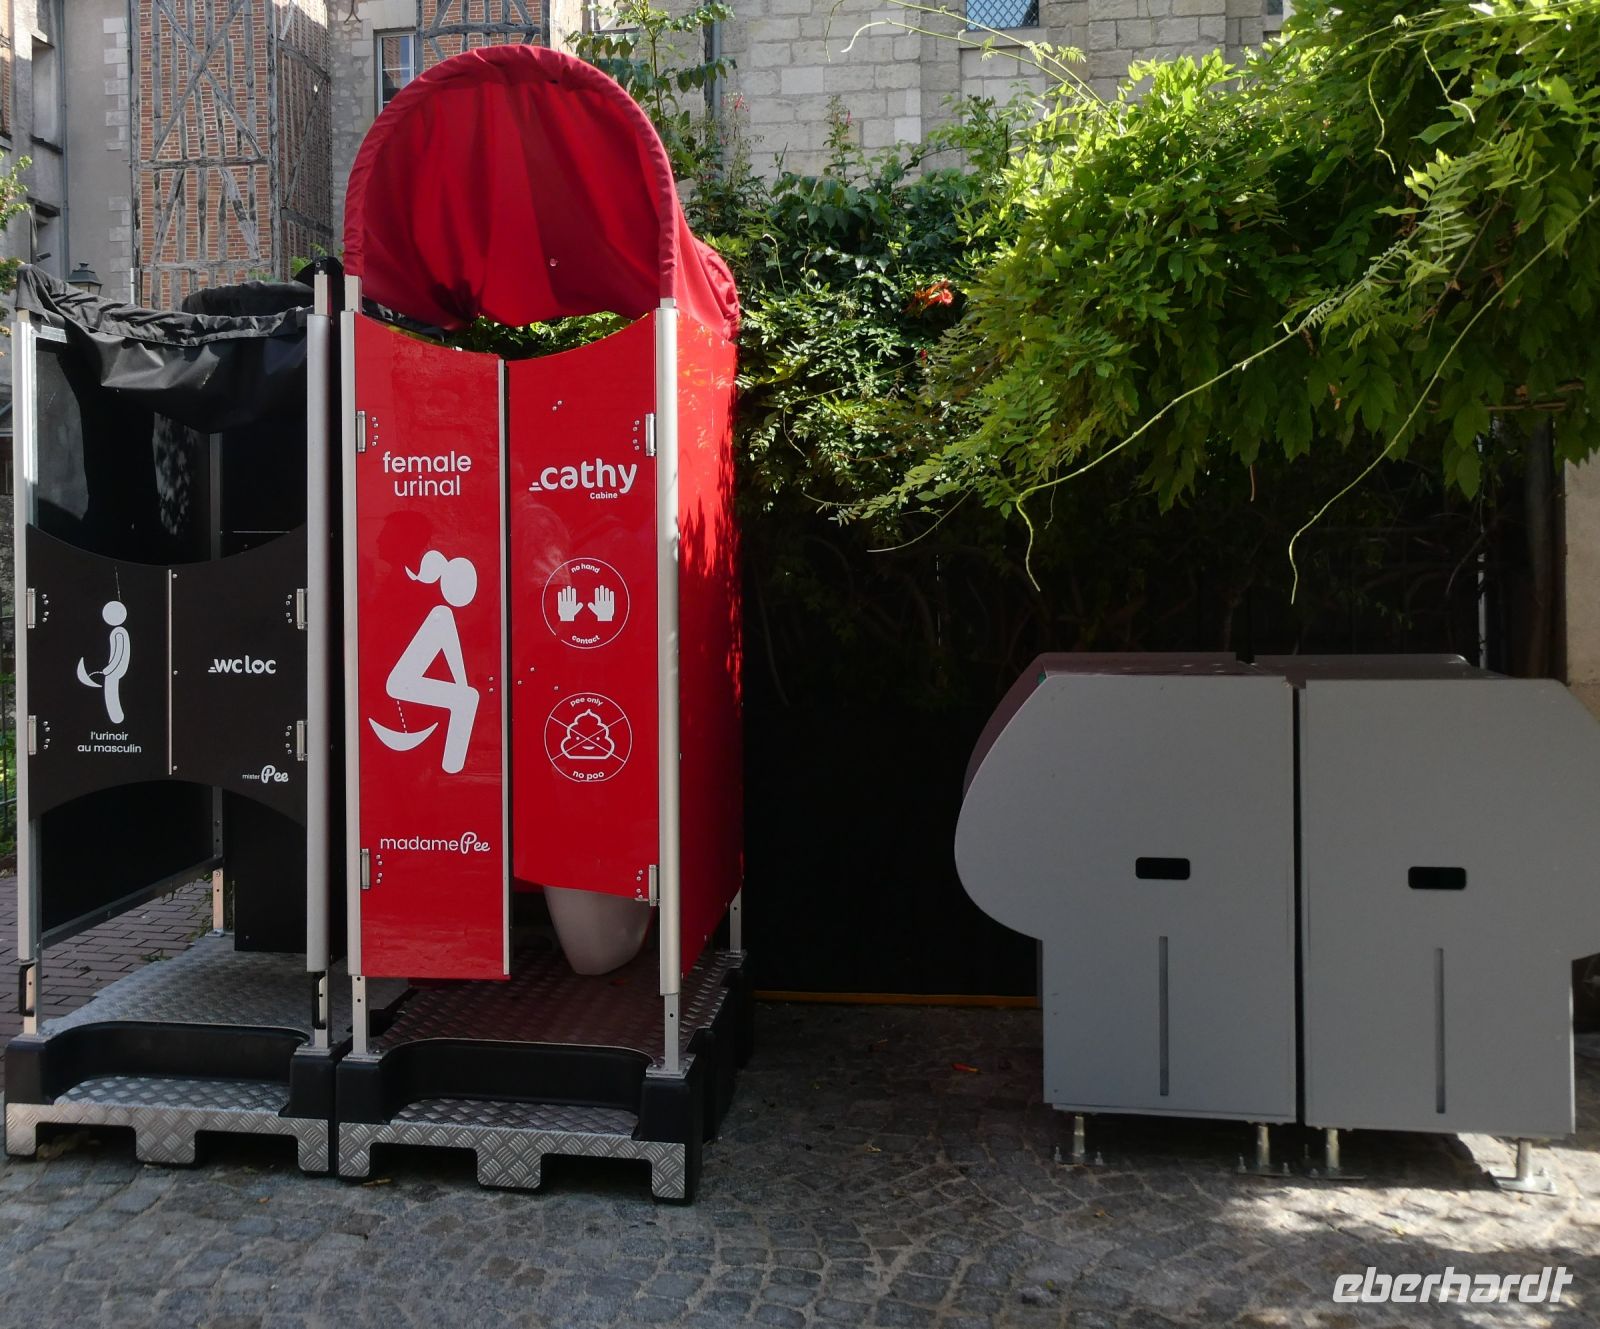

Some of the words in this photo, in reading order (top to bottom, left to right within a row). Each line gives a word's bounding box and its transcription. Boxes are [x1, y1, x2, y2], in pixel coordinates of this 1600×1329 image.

[382, 450, 472, 473] female
[540, 457, 638, 494] cathy
[394, 474, 461, 497] urinal
[589, 491, 618, 500] Cabine
[570, 565, 580, 574] no
[581, 562, 600, 574] hand
[571, 634, 600, 645] contact
[569, 696, 585, 708] pee
[586, 697, 604, 707] only
[77, 744, 92, 752] au
[93, 743, 142, 753] masculin
[572, 770, 585, 779] no
[586, 771, 605, 781] poo
